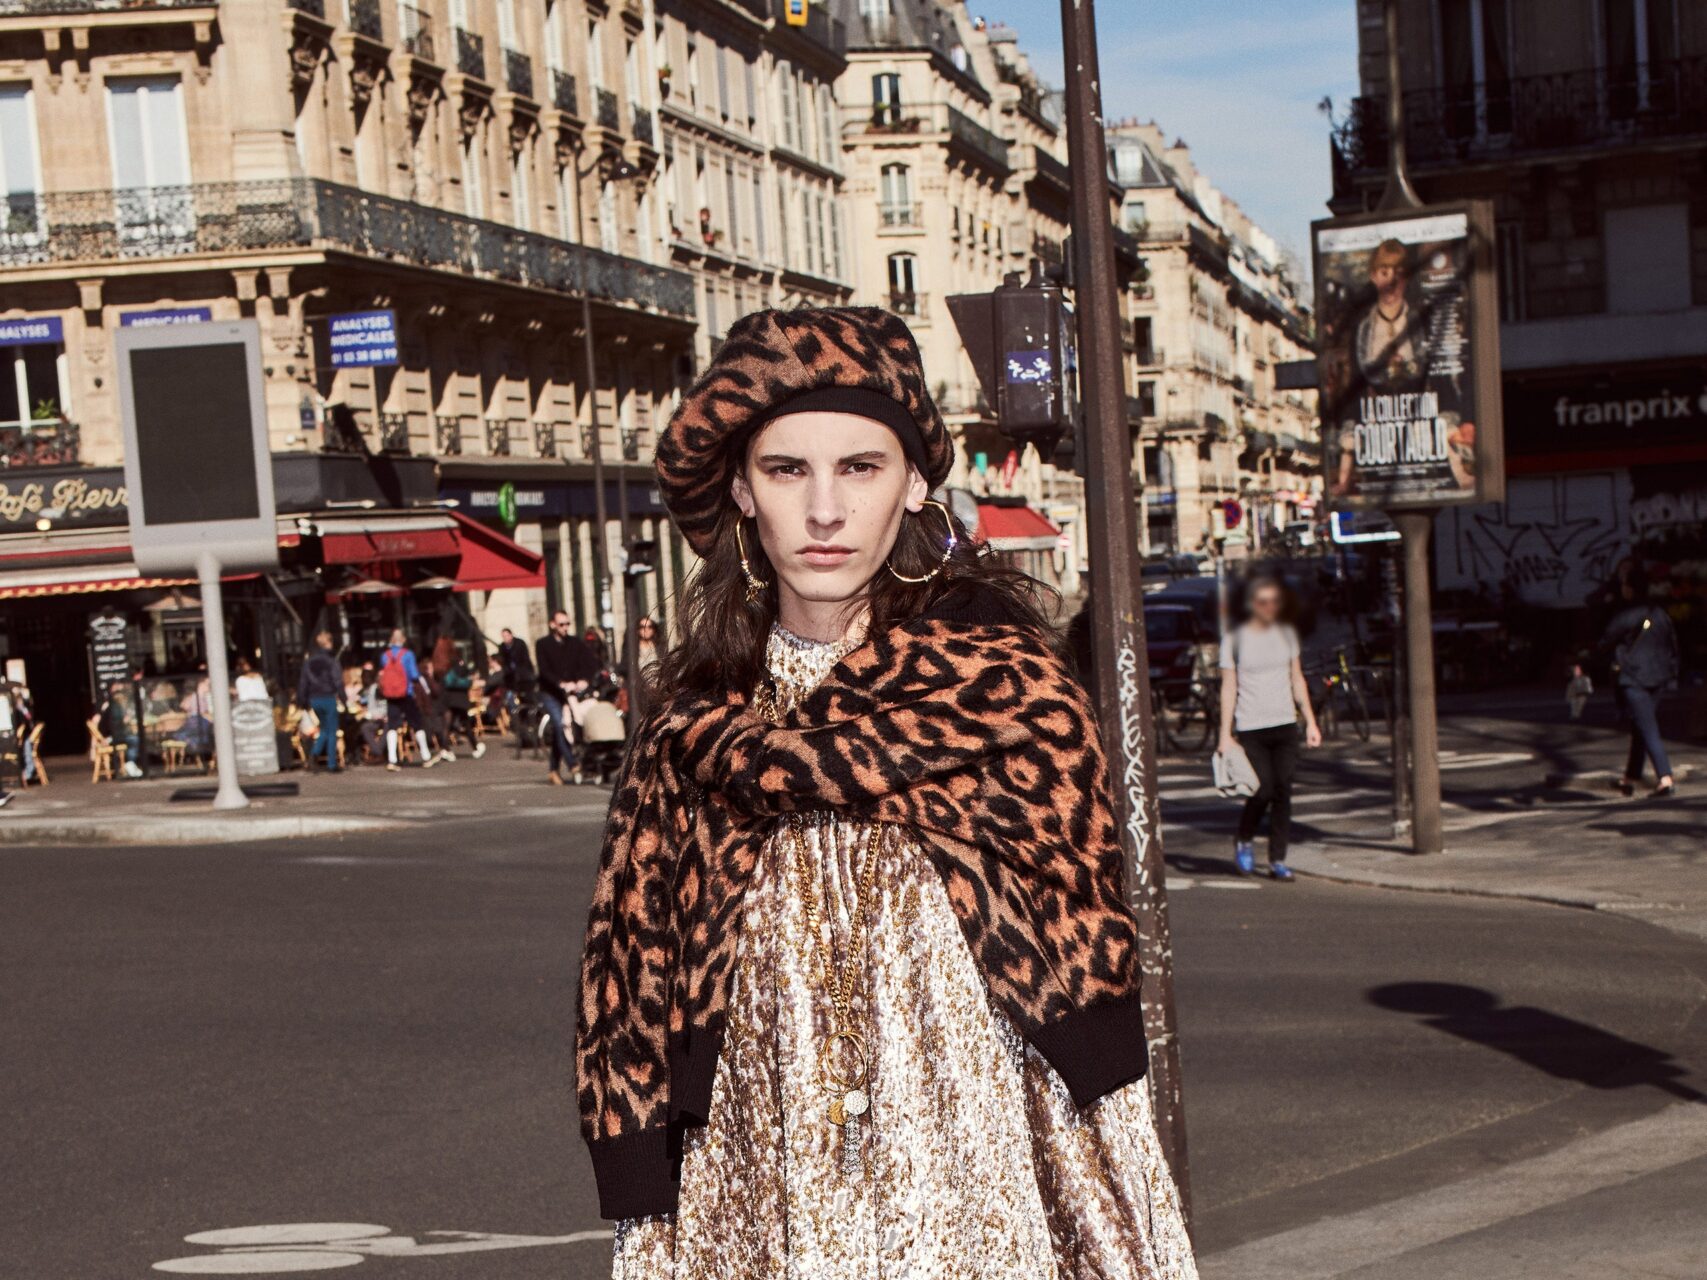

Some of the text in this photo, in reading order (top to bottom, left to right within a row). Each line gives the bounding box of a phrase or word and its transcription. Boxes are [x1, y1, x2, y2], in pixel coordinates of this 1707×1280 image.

[332, 316, 391, 332] ANALYSES
[1360, 391, 1438, 423] LA COLLECTION
[1554, 389, 1691, 427] franprix
[1354, 417, 1448, 465] COURTAULD
